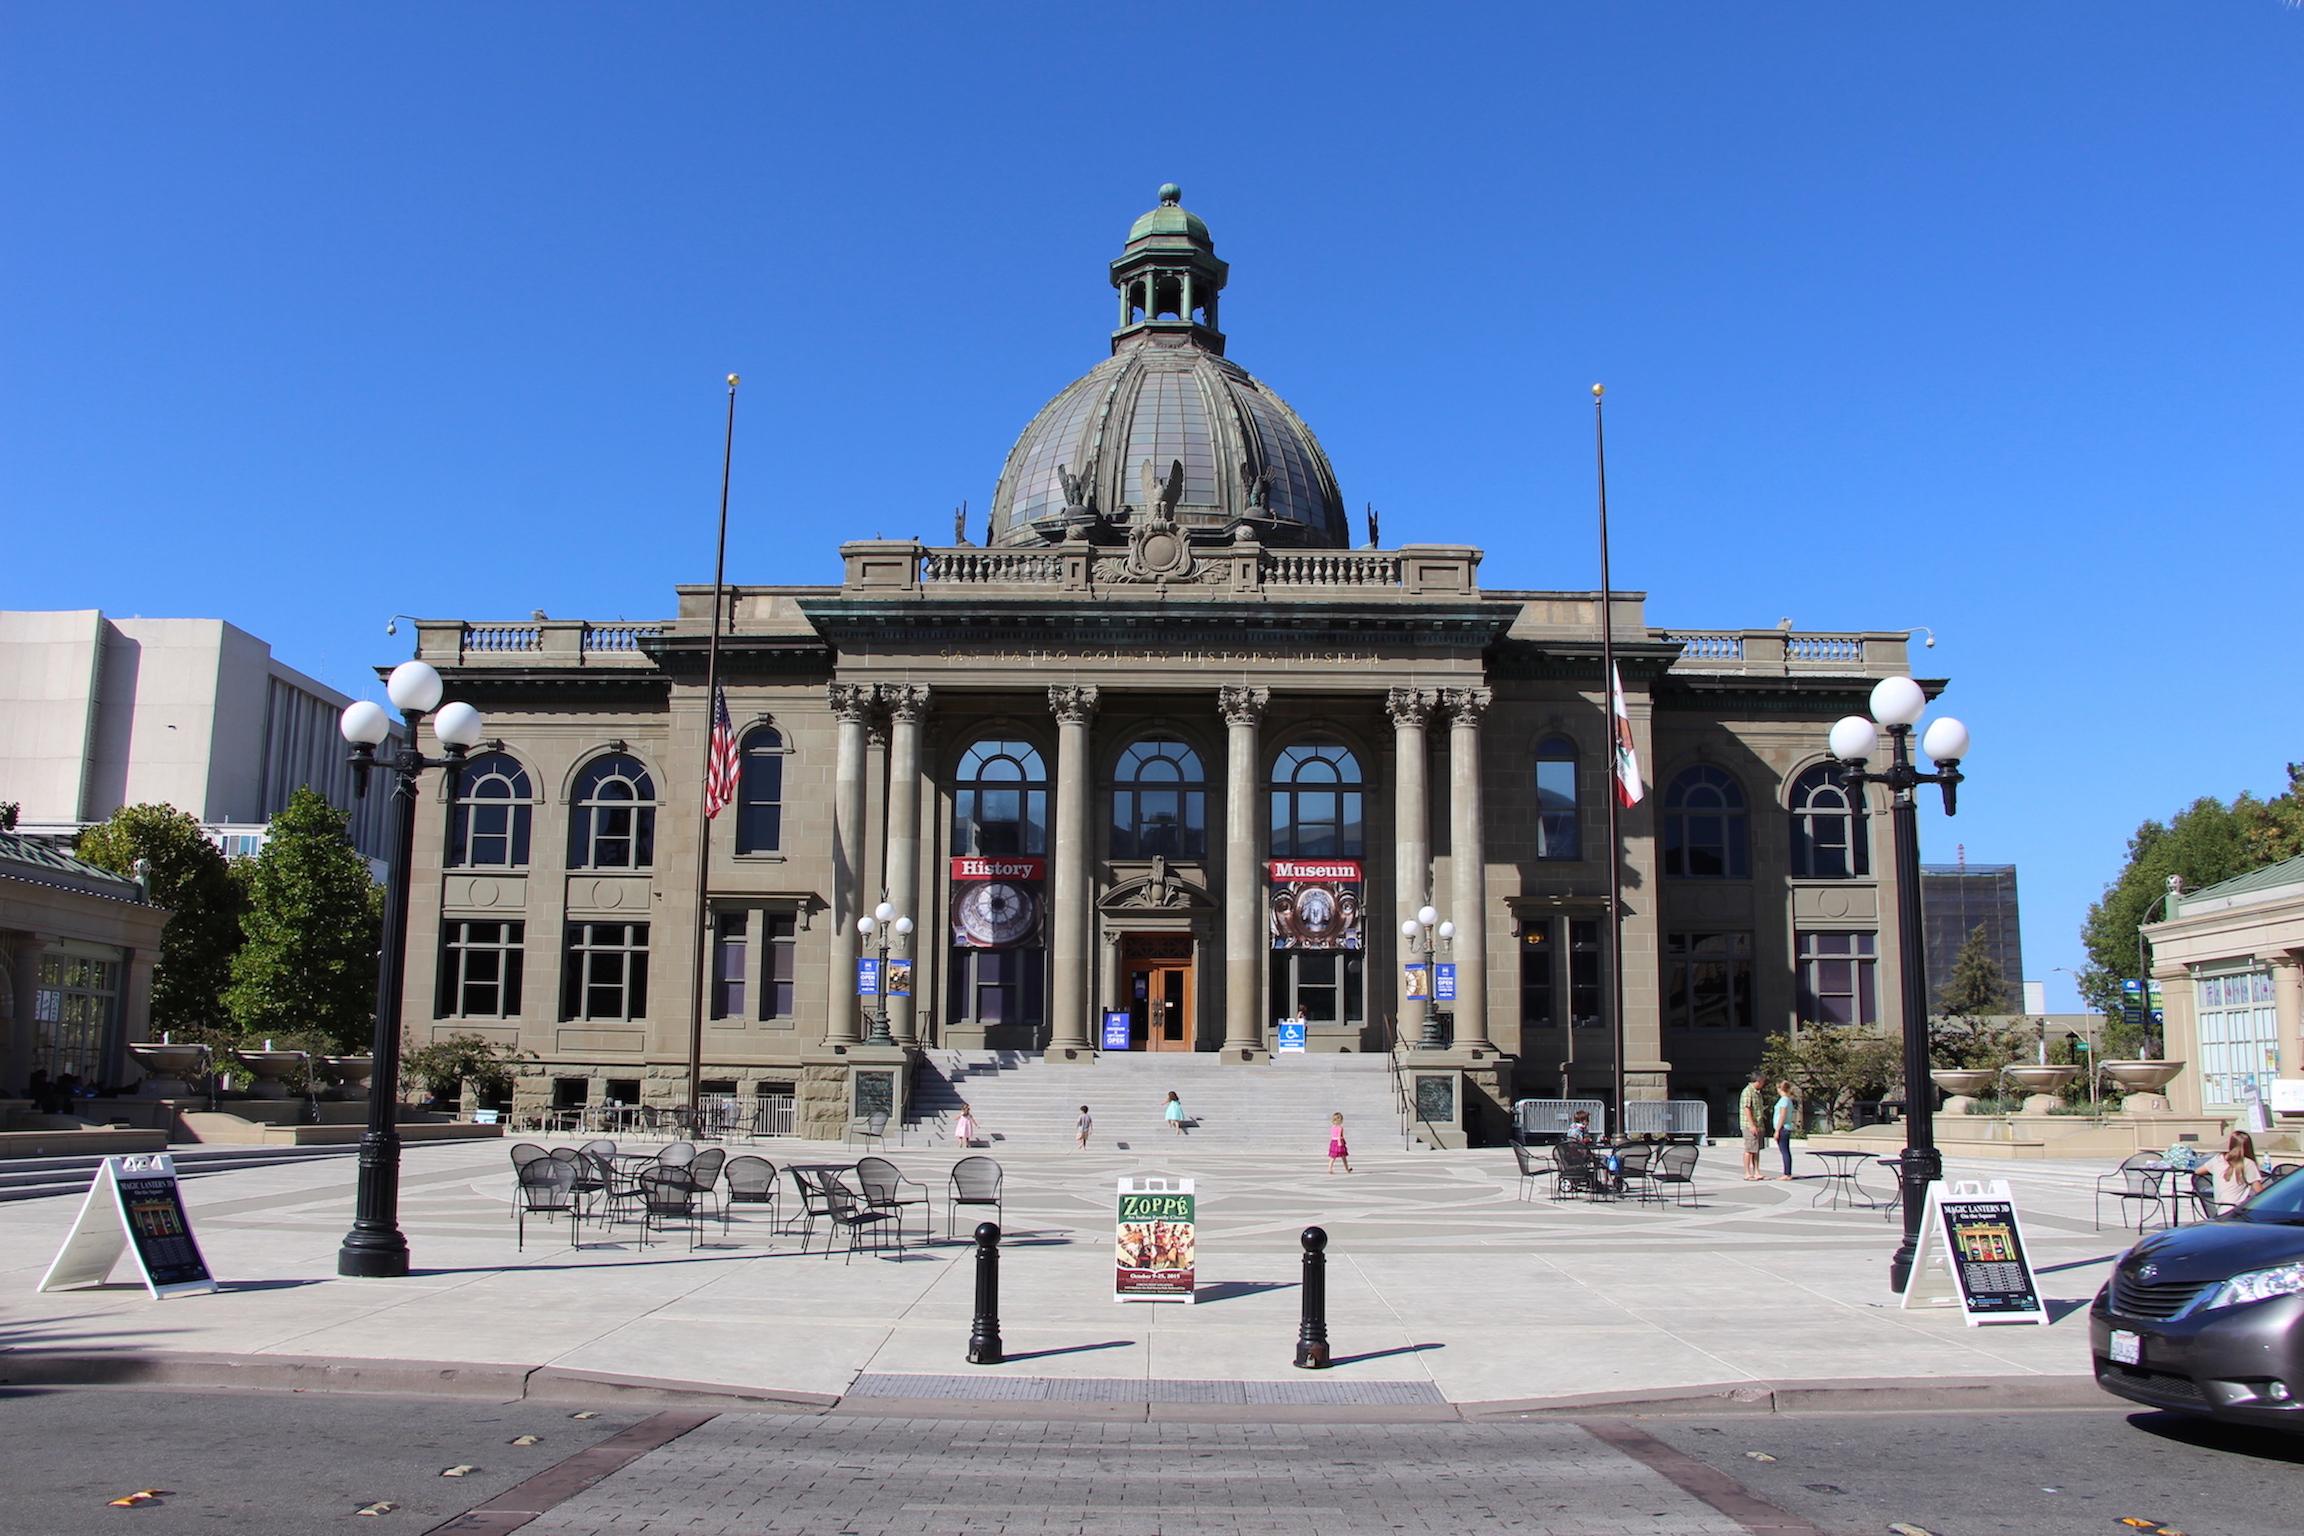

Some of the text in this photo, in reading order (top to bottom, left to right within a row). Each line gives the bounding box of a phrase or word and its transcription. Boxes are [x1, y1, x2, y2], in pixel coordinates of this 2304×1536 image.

[940, 650, 1379, 664] SAN MATEO COUNTY HISTORY MUSEUM
[961, 861, 1033, 878] History
[1275, 862, 1355, 877] Museum
[1943, 1205, 1968, 1213] MAGIC
[1968, 1204, 2000, 1213] LANTERN
